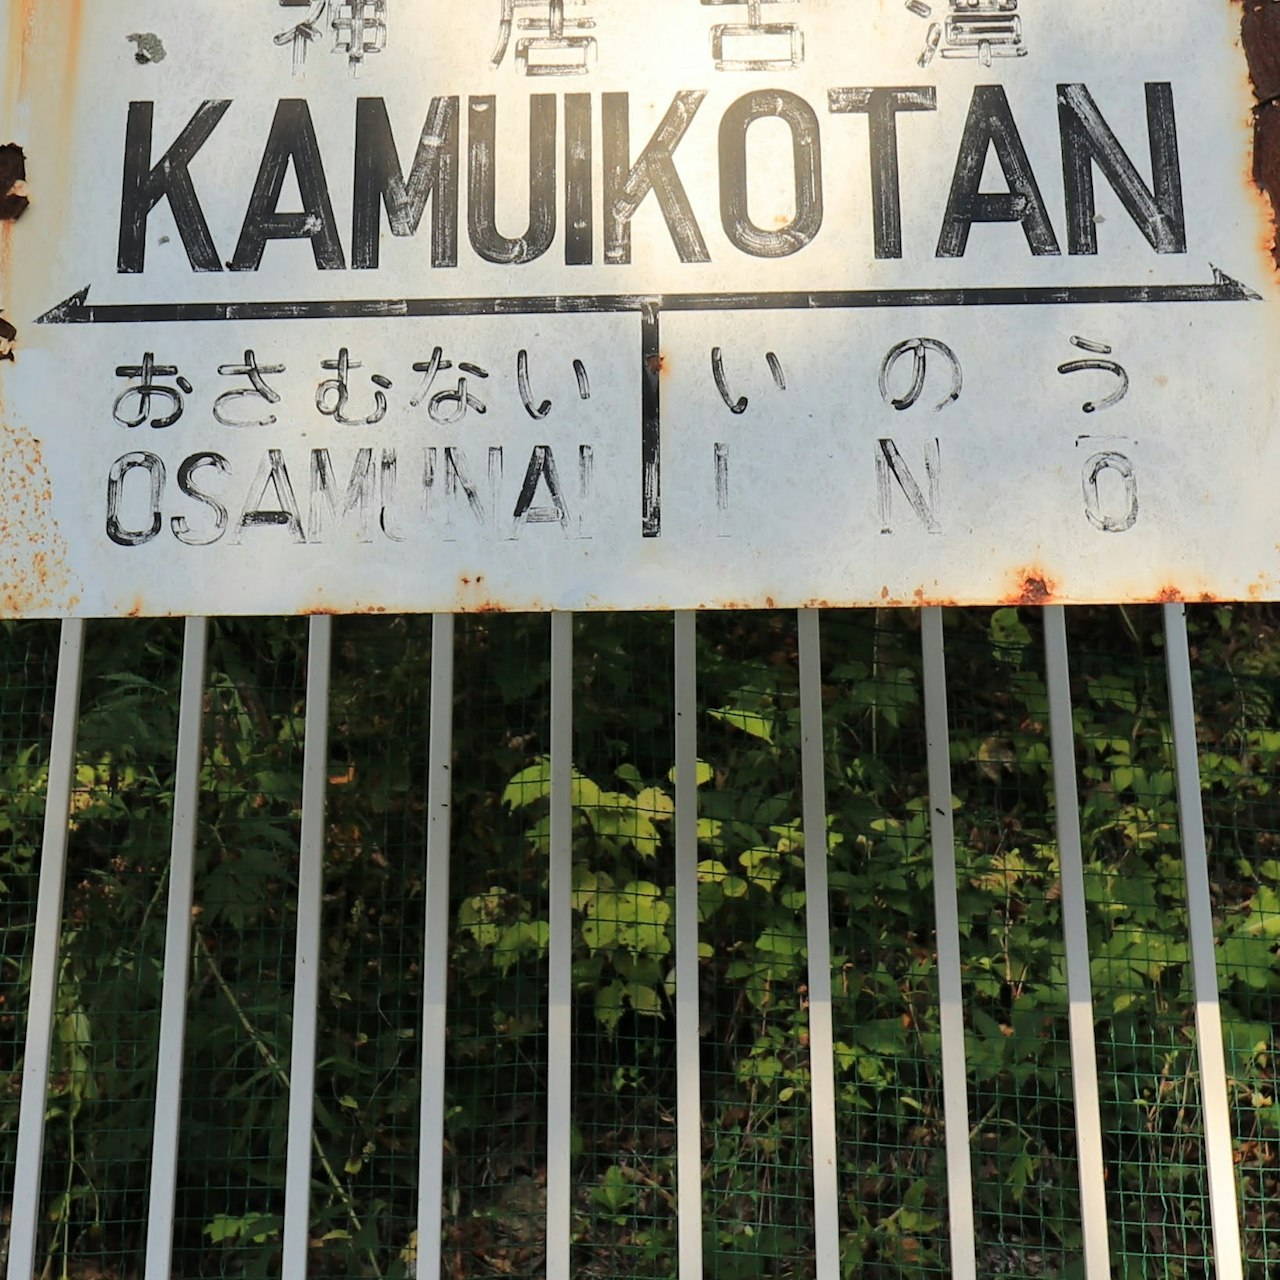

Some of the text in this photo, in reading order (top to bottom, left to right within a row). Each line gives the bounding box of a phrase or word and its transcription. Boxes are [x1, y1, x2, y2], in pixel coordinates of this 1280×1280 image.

[116, 81, 1188, 274] KAMUIKOTAN
[112, 345, 591, 429] おさむない
